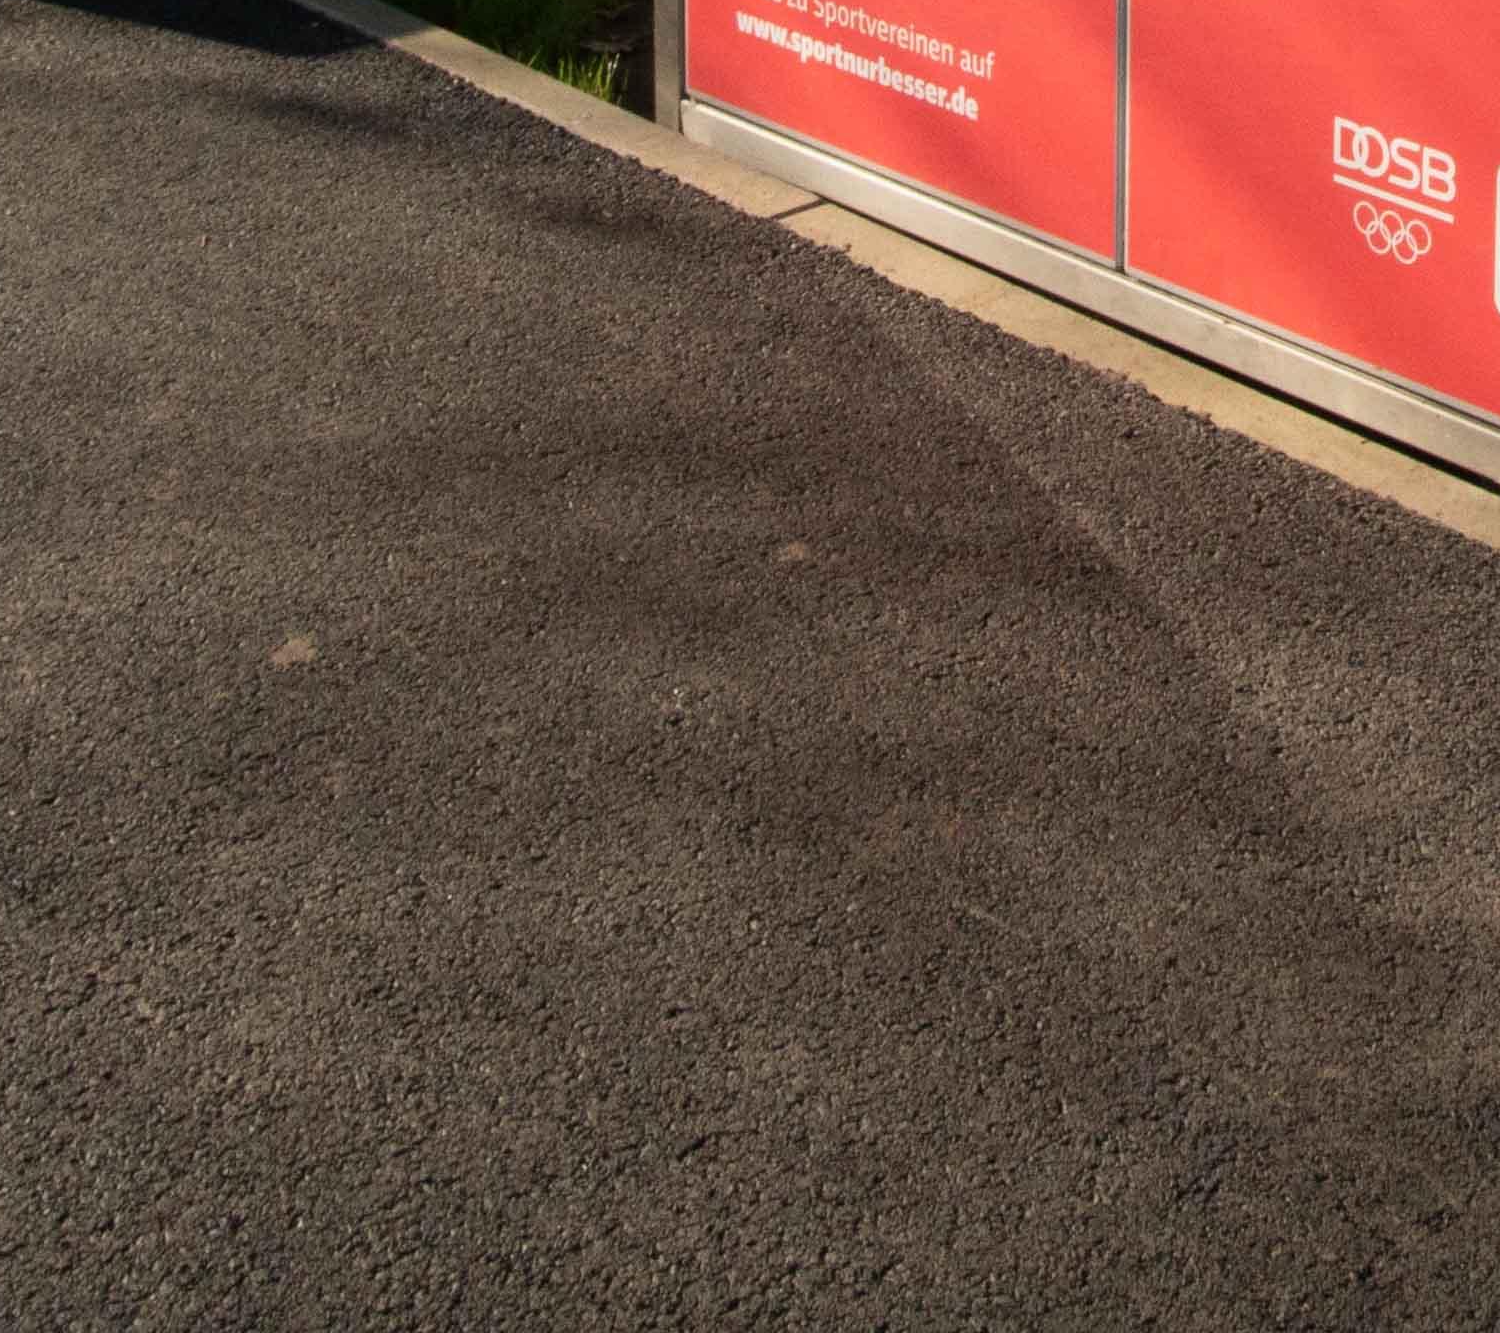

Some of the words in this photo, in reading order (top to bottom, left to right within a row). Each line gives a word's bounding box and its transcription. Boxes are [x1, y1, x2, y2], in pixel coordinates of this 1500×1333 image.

[735, 10, 980, 122] www.sportnurbesser.de
[959, 48, 996, 81] auf
[1332, 115, 1457, 203] DOSB
